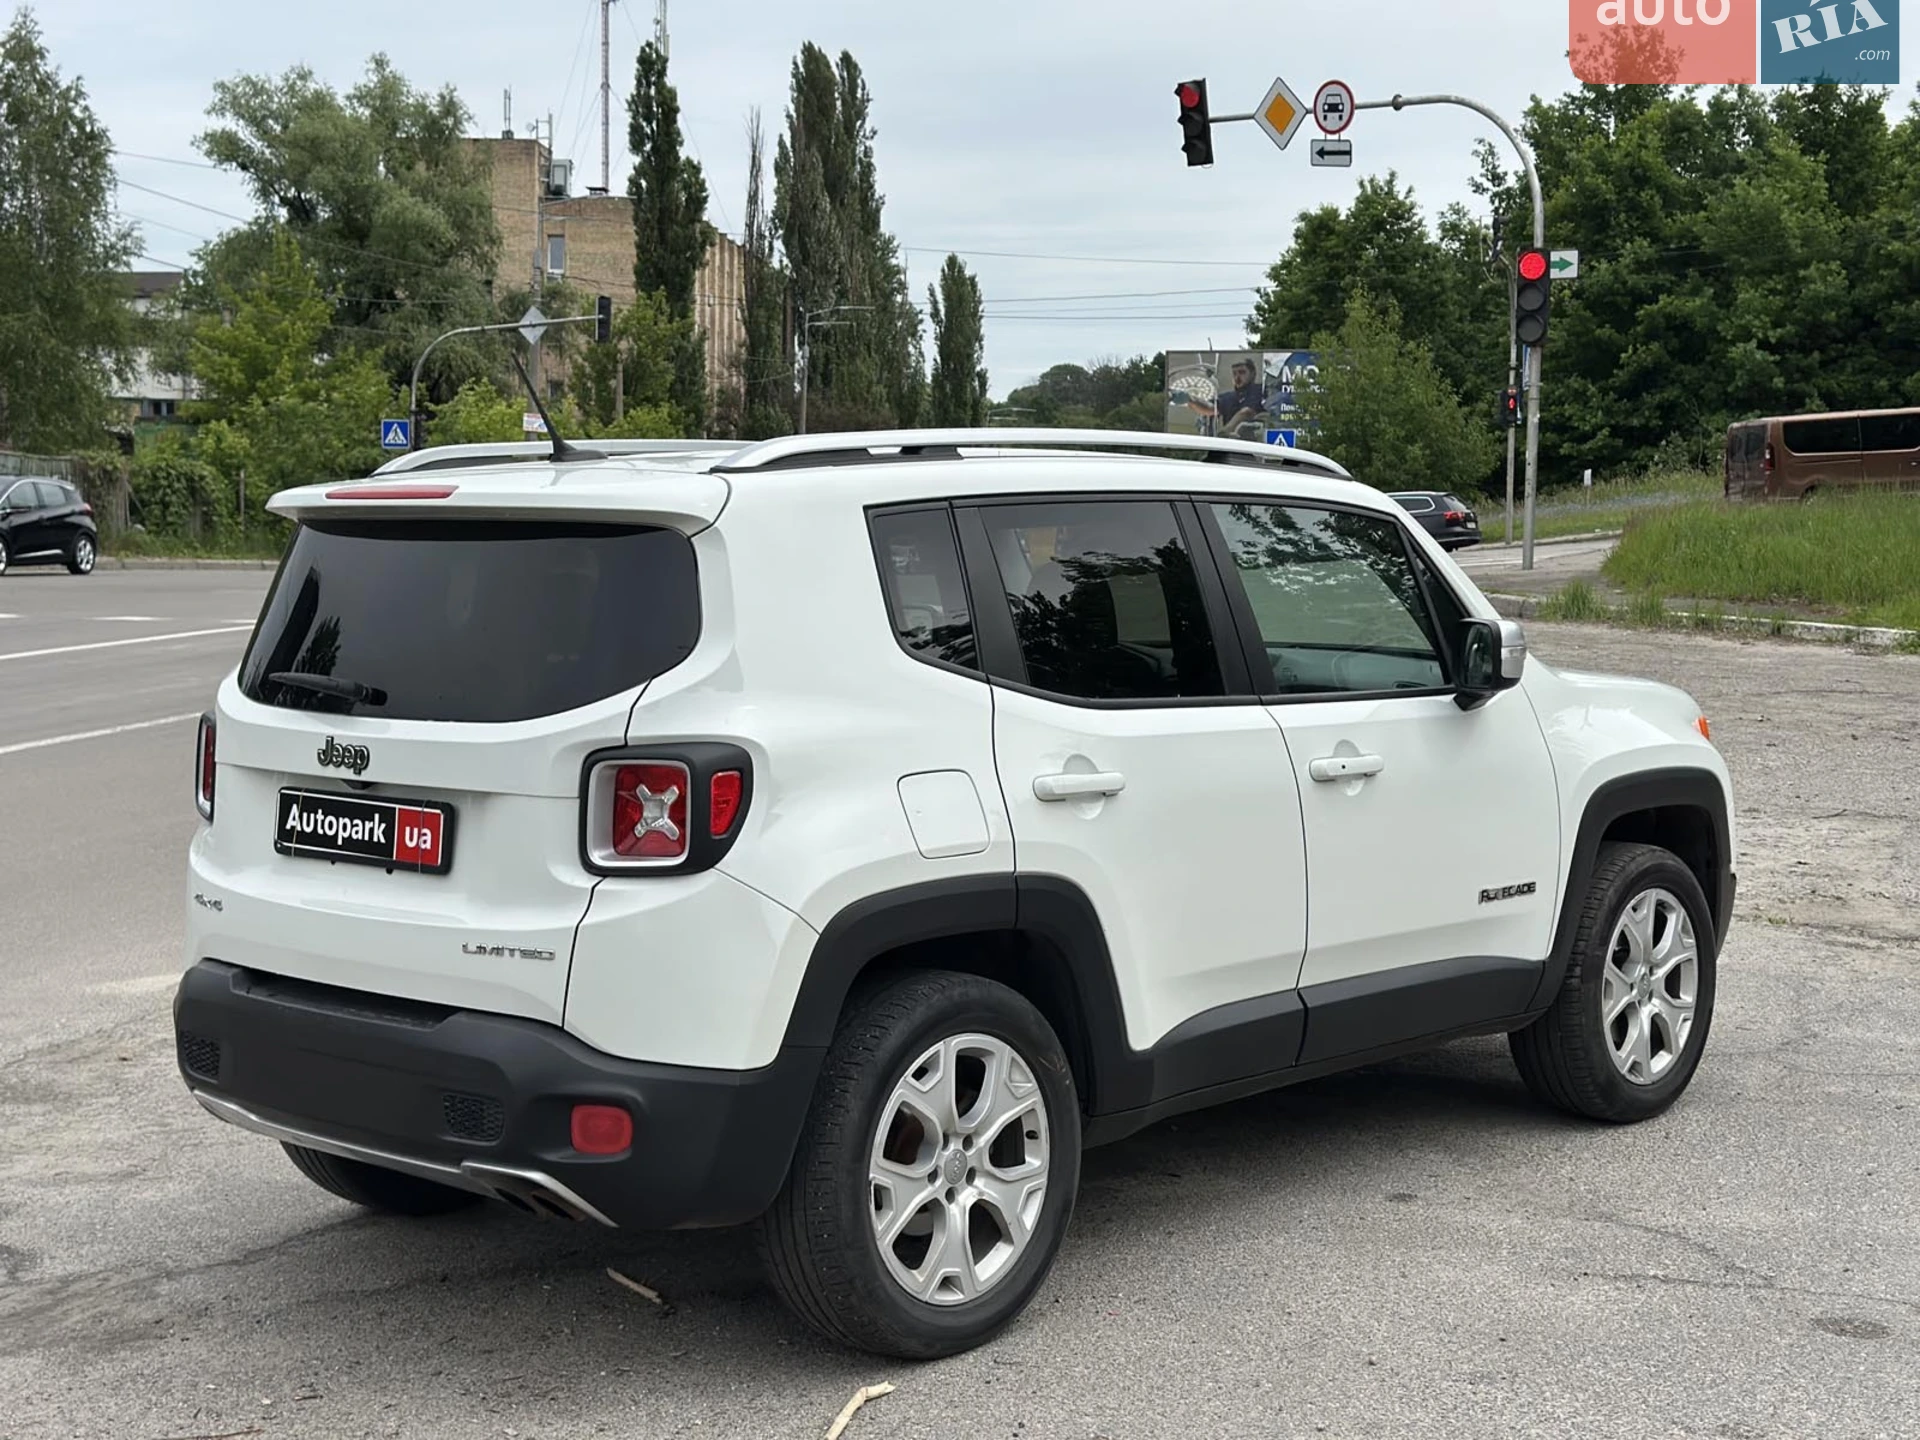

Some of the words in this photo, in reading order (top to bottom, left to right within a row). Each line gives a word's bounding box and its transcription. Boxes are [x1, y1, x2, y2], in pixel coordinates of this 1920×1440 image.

[317, 735, 370, 776] Jeep
[285, 803, 387, 846] Autopark
[404, 825, 432, 850] ua
[461, 942, 556, 961] LIMITED
